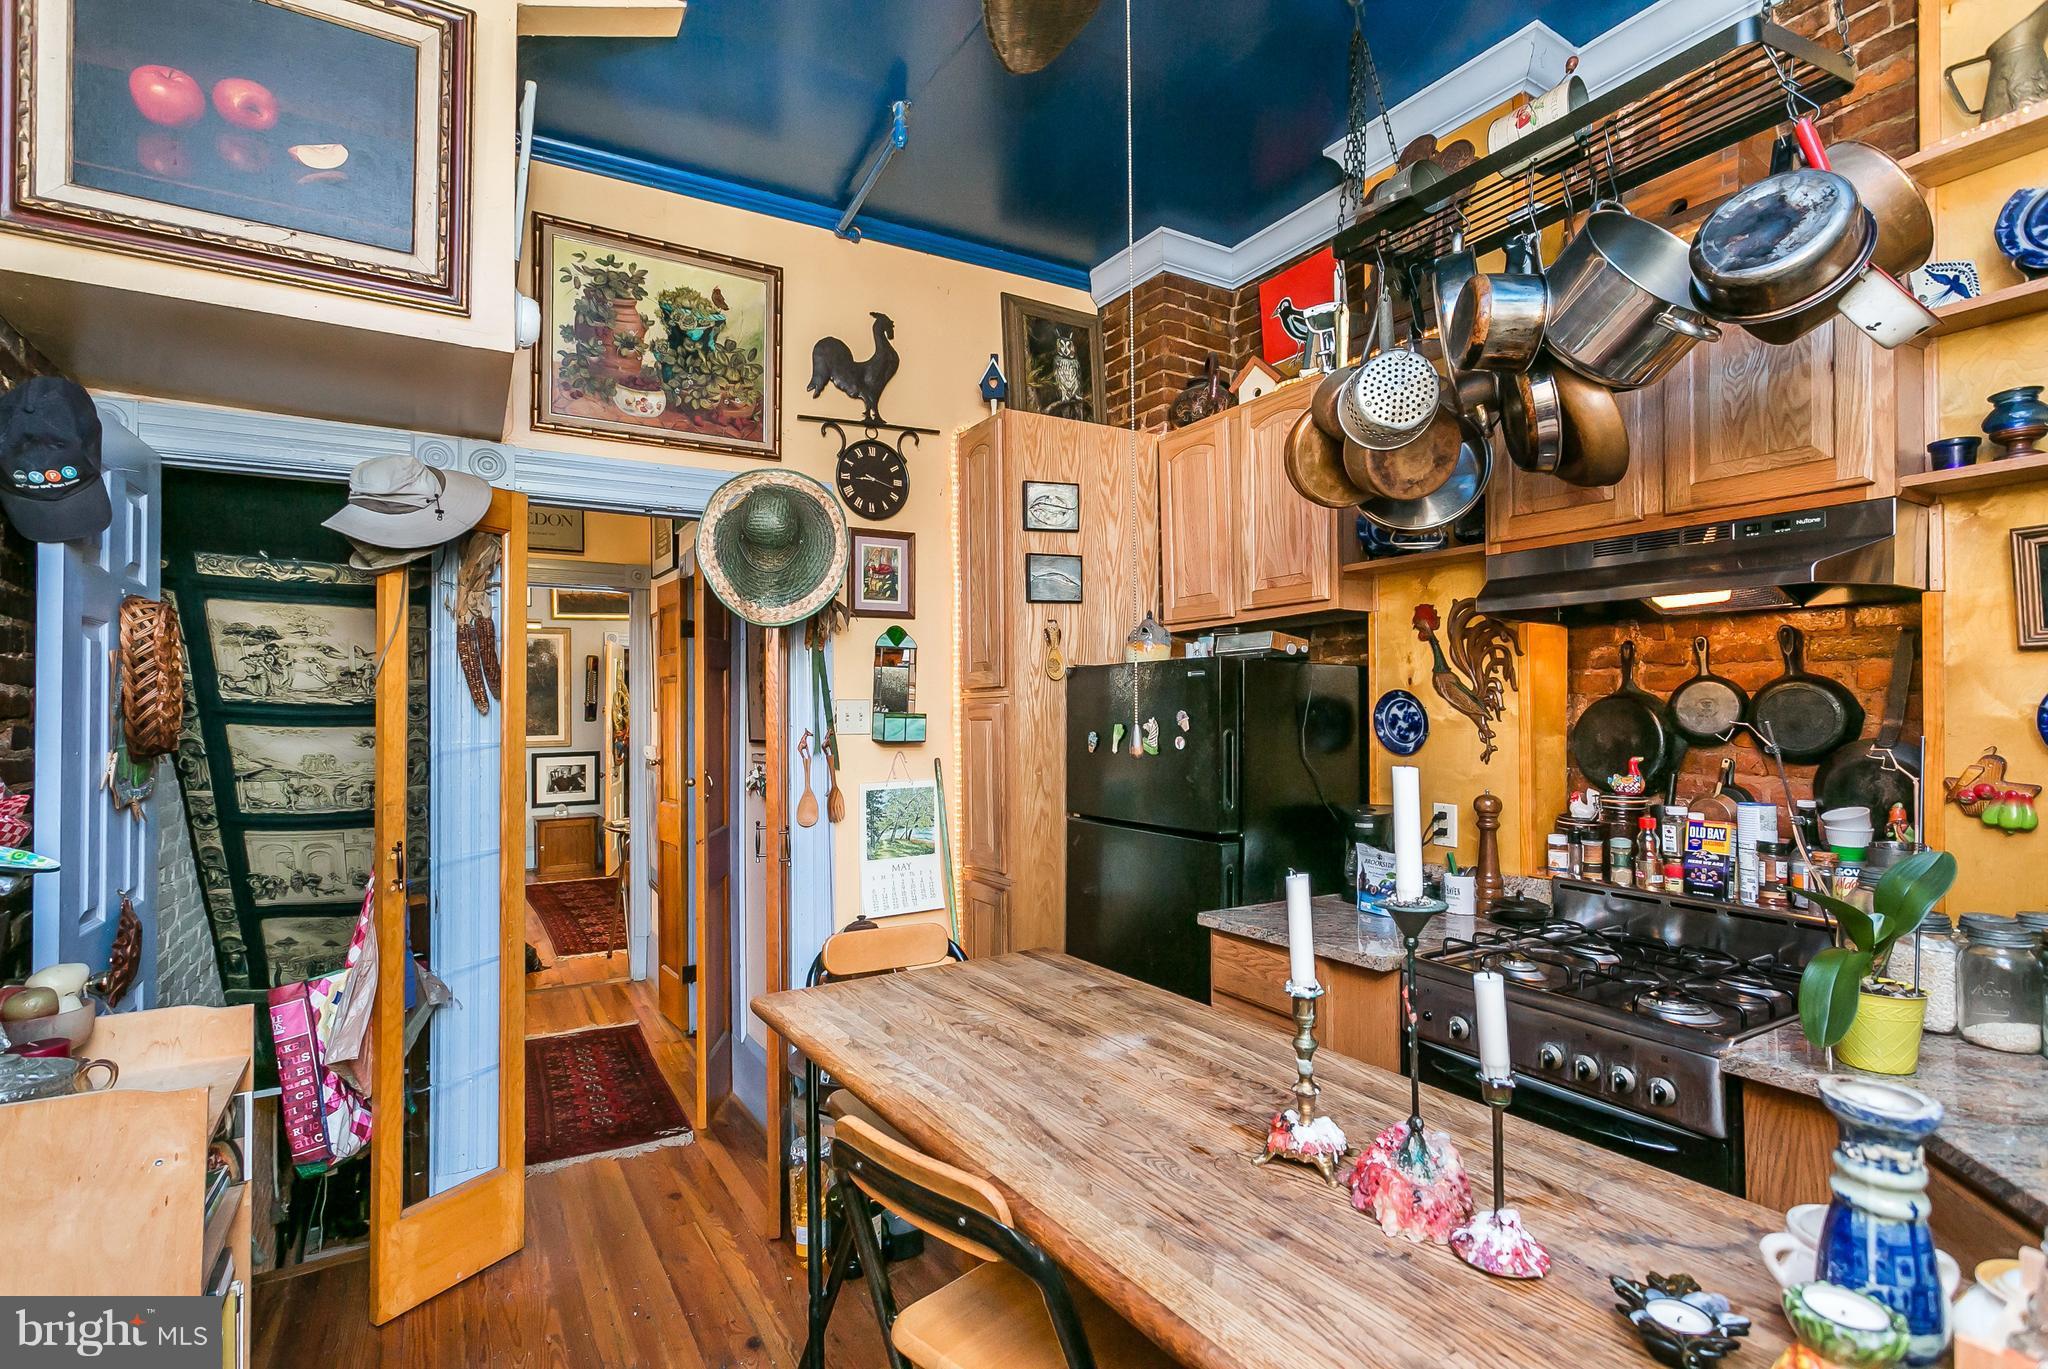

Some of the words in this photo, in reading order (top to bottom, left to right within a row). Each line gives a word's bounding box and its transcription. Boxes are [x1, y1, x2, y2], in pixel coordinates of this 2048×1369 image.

[1690, 826, 1706, 838] OLD
[1707, 828, 1726, 840] BAY
[892, 862, 912, 872] MAY
